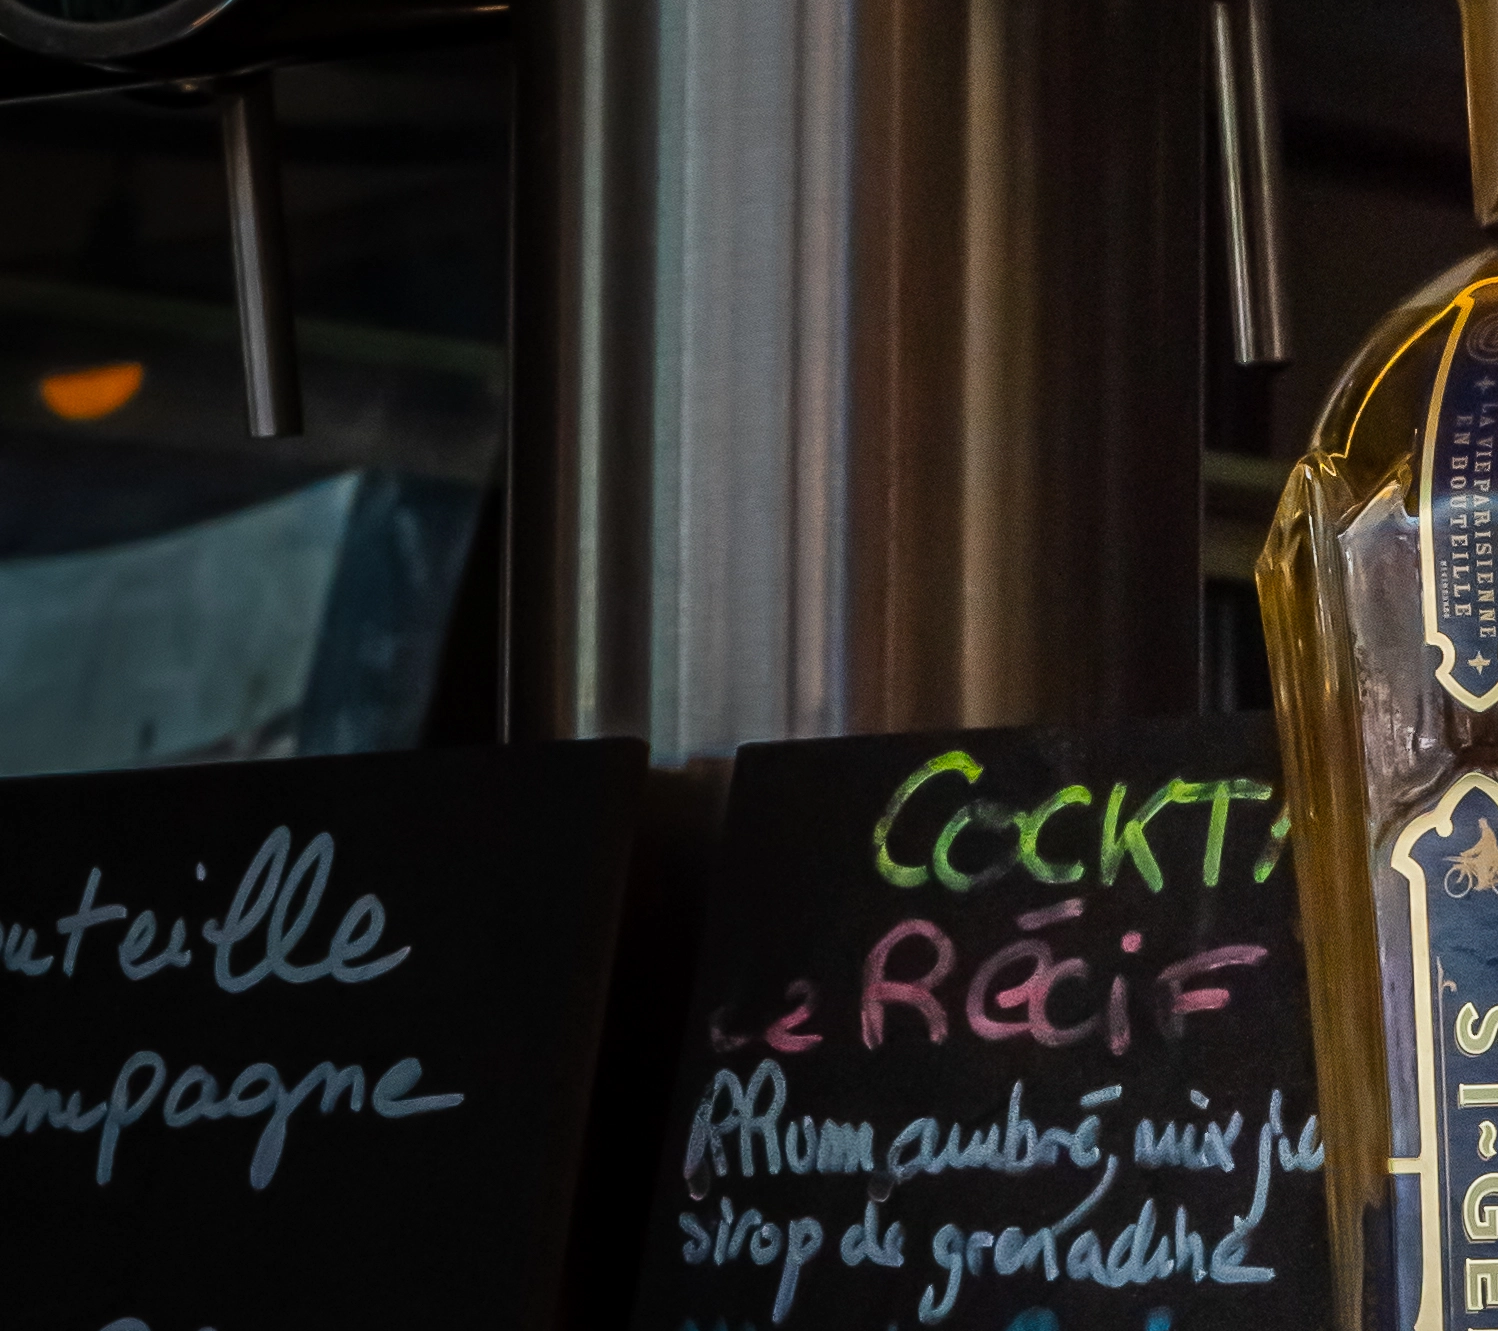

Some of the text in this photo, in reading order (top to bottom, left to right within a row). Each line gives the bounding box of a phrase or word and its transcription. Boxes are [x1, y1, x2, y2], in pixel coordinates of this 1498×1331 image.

[1449, 415, 1473, 619] EN BOUTEILLE
[1472, 402, 1498, 640] LA VIE PARISIENNE
[0, 825, 411, 994] uteille
[679, 1196, 823, 1324] sirop
